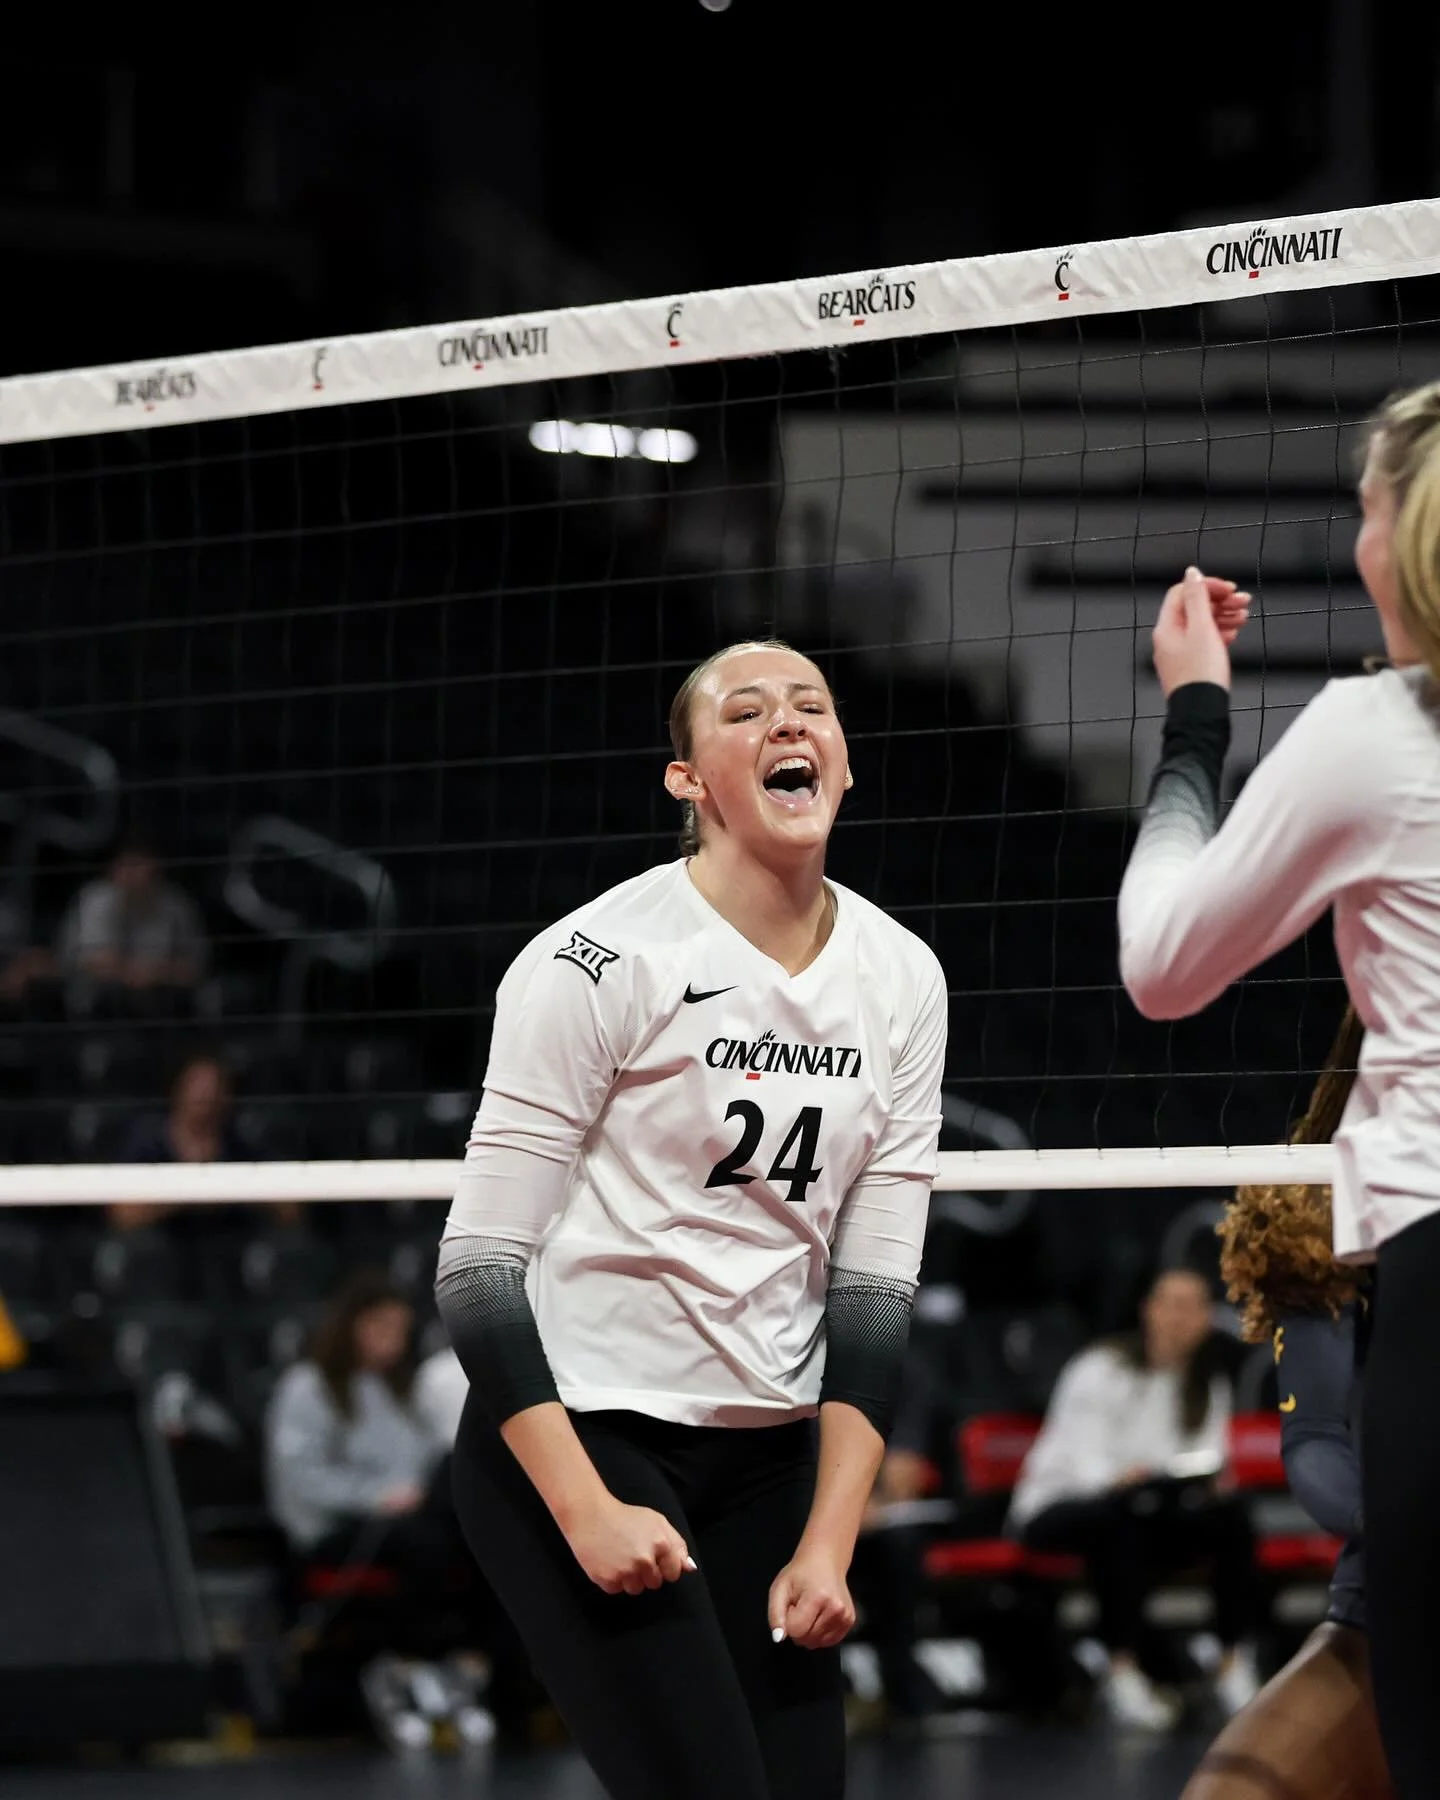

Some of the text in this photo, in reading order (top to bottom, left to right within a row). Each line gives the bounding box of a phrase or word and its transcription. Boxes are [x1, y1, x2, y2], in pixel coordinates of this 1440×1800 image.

[1054, 252, 1073, 292] C
[1206, 227, 1344, 275] CINCINNATI
[666, 302, 683, 339] C
[818, 276, 916, 320] BEARCATS
[705, 1031, 862, 1078] CINCINNATI
[703, 1099, 824, 1202] 24
